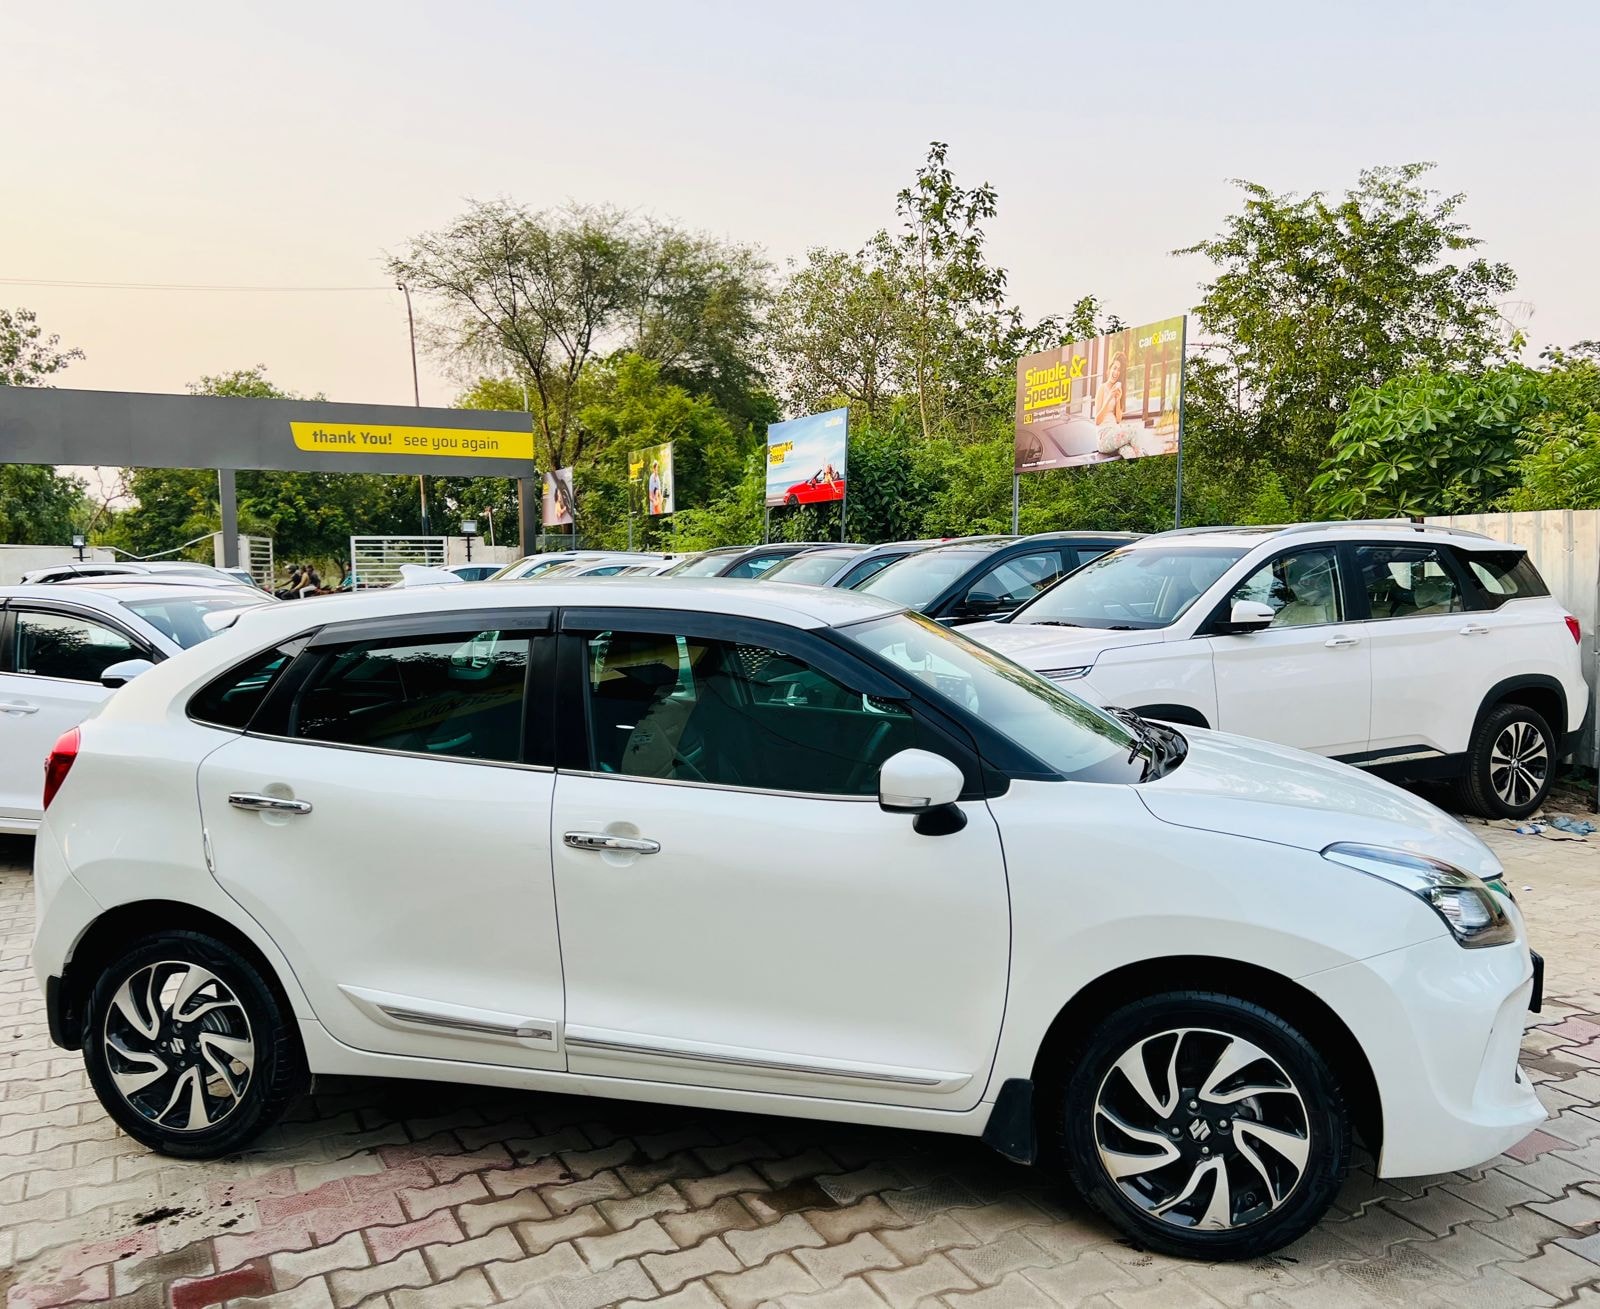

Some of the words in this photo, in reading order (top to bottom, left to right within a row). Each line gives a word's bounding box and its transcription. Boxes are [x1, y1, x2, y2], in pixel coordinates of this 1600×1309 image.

[1025, 361, 1067, 387] Simple
[1070, 354, 1087, 378] &
[1025, 379, 1071, 407] Speedy
[312, 429, 356, 444] thank
[361, 432, 392, 445] You!
[404, 436, 428, 447] see
[432, 437, 457, 450] you
[461, 437, 499, 452] again
